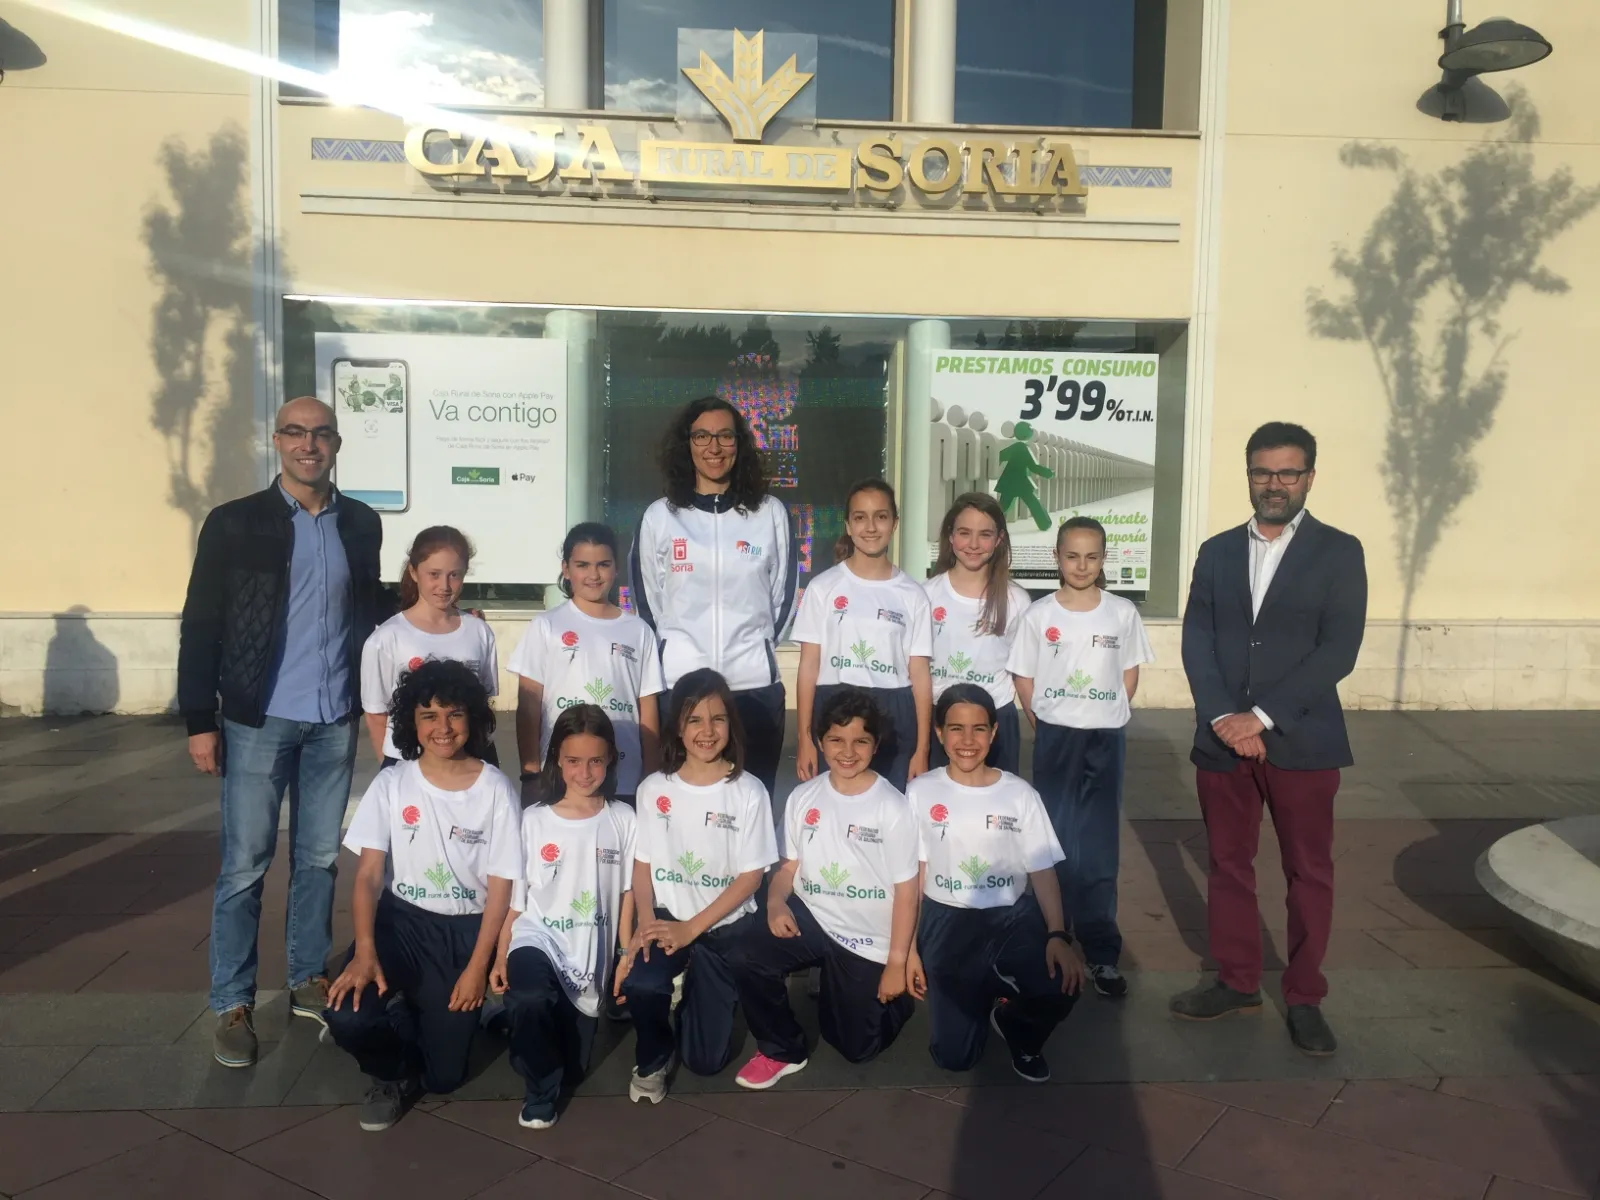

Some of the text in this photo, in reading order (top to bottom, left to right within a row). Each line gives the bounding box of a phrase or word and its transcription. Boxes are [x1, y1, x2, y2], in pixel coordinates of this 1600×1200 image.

[404, 117, 1088, 196] CAJA RURAL DE SORIA
[935, 356, 1156, 377] PRESTAMOS CONSUMO
[429, 399, 557, 429] Va contigo
[519, 473, 536, 483] Pay
[1104, 528, 1148, 546] ayoría
[1088, 687, 1117, 701] Soria
[397, 882, 427, 900] Caja
[846, 885, 886, 899] Soria
[935, 874, 962, 893] Caja
